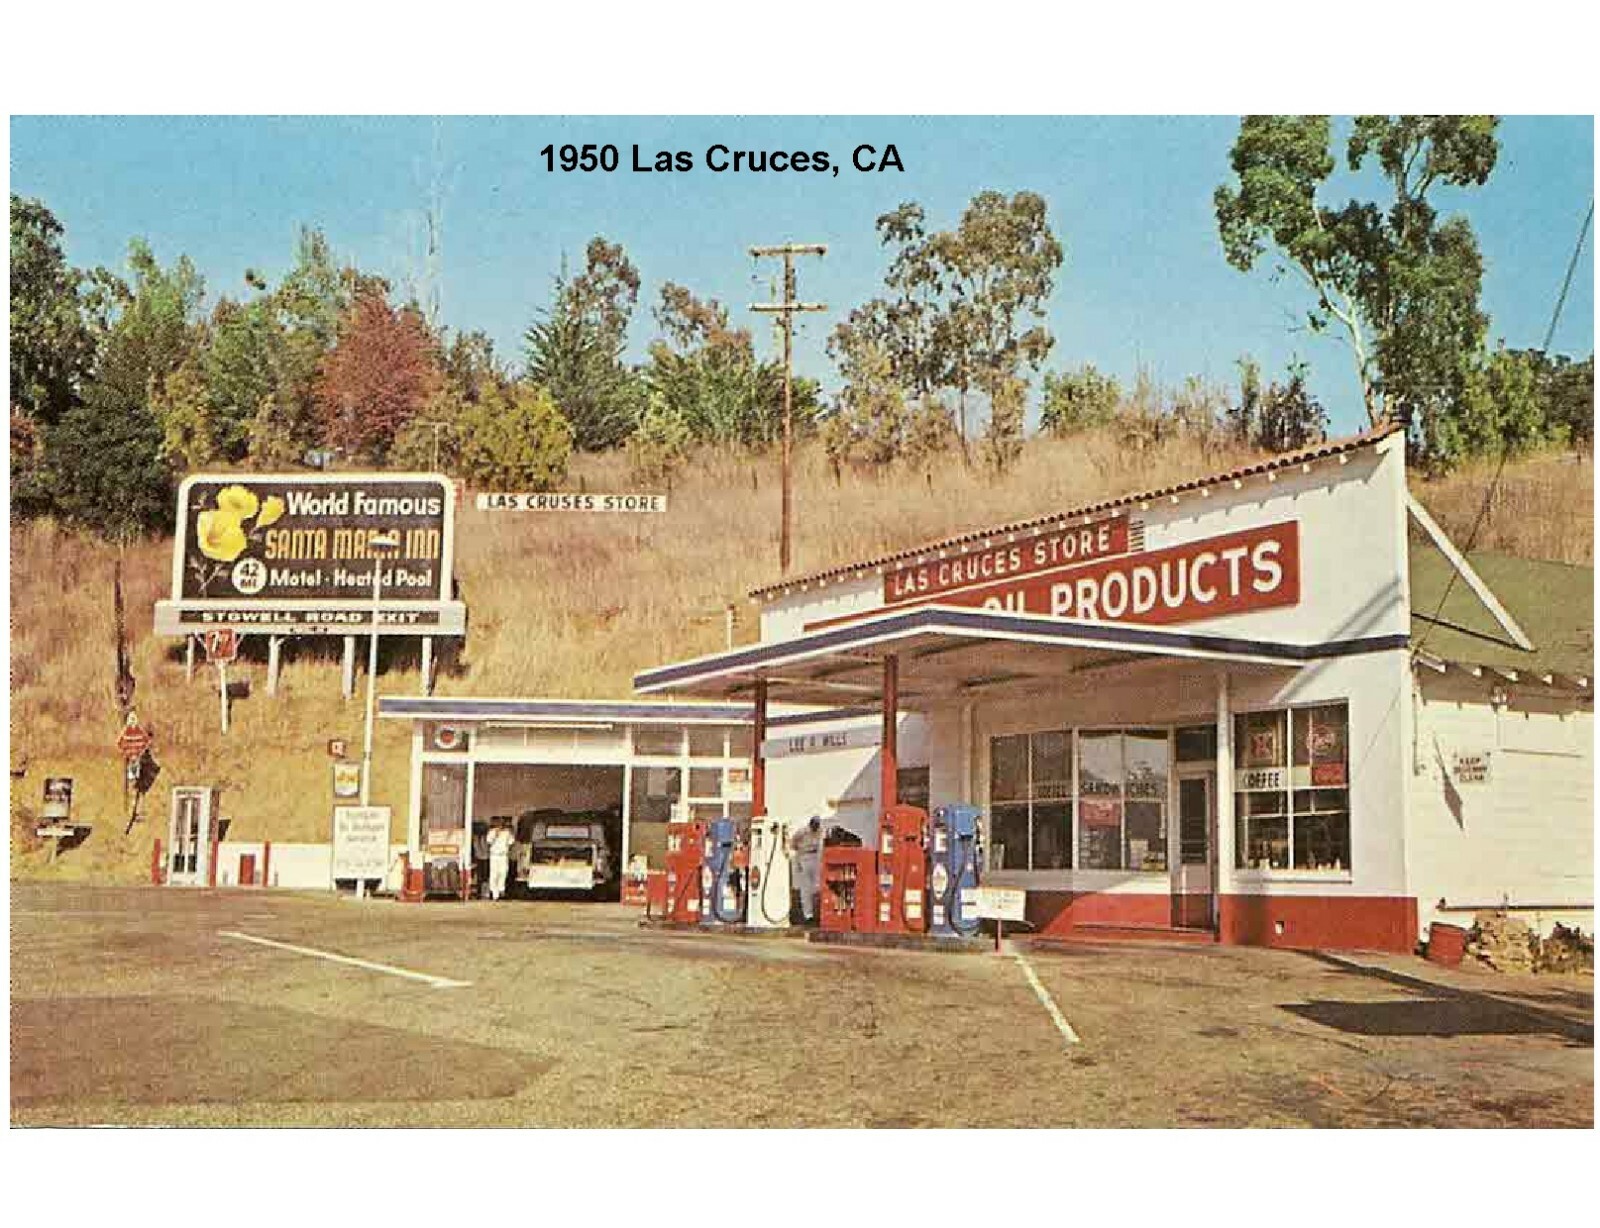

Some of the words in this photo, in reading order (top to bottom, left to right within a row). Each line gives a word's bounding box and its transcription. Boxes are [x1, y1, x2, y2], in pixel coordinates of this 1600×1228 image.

[286, 491, 349, 515] World
[354, 491, 441, 515] Famous
[487, 496, 518, 509] LAS
[603, 496, 659, 510] STORE
[265, 528, 327, 559] SANTA
[333, 528, 399, 559] MARA
[406, 528, 440, 559] INN
[240, 563, 259, 576] 42
[894, 569, 928, 595] LAS
[938, 548, 1021, 586] CRUCES
[1034, 524, 1110, 564] STORE
[396, 568, 432, 587] Pool
[1051, 539, 1283, 621] PRODUCTS
